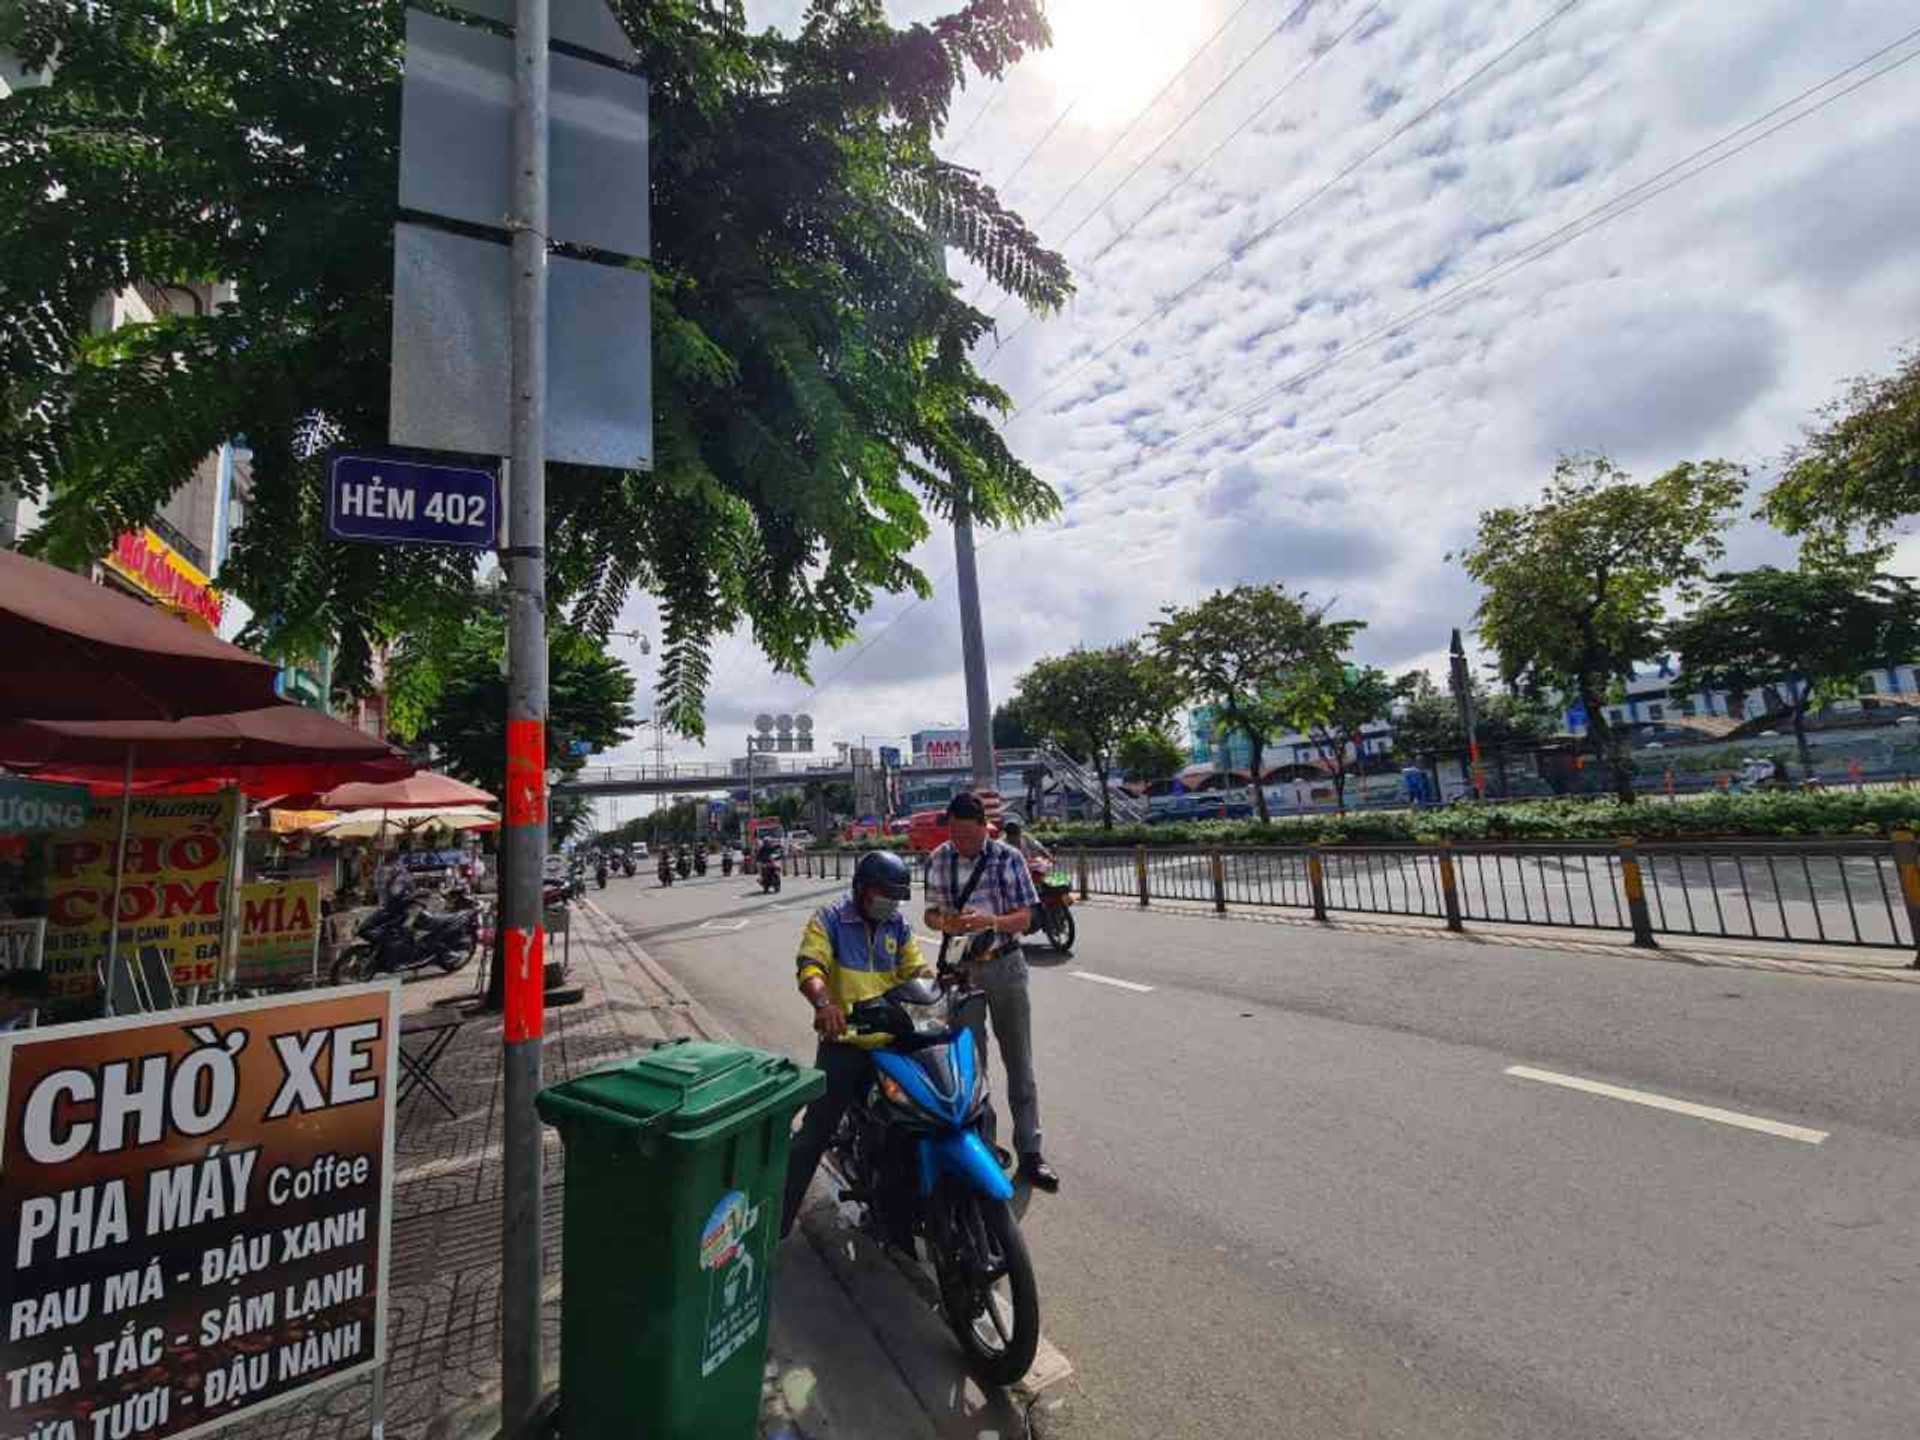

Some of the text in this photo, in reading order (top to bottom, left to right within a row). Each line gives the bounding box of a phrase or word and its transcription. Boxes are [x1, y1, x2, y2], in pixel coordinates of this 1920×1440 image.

[341, 475, 487, 527] HẺM 402
[243, 887, 313, 935] MÍA
[23, 1021, 381, 1165] CHỜ XE
[16, 1144, 370, 1269] PHA MÁY Coffee
[6, 1346, 81, 1410] TRÀ
[94, 1319, 165, 1382] TẮC
[200, 1295, 275, 1348] SÂM
[286, 1264, 365, 1321] LẠNH
[10, 1283, 91, 1342] RAU
[103, 1256, 165, 1315] MÁ
[201, 1234, 272, 1286] ĐẬU
[280, 1208, 367, 1263] XANH
[90, 1387, 170, 1440] TƯƠI
[204, 1354, 270, 1408] ĐẬU
[278, 1320, 362, 1383] NÀNH
